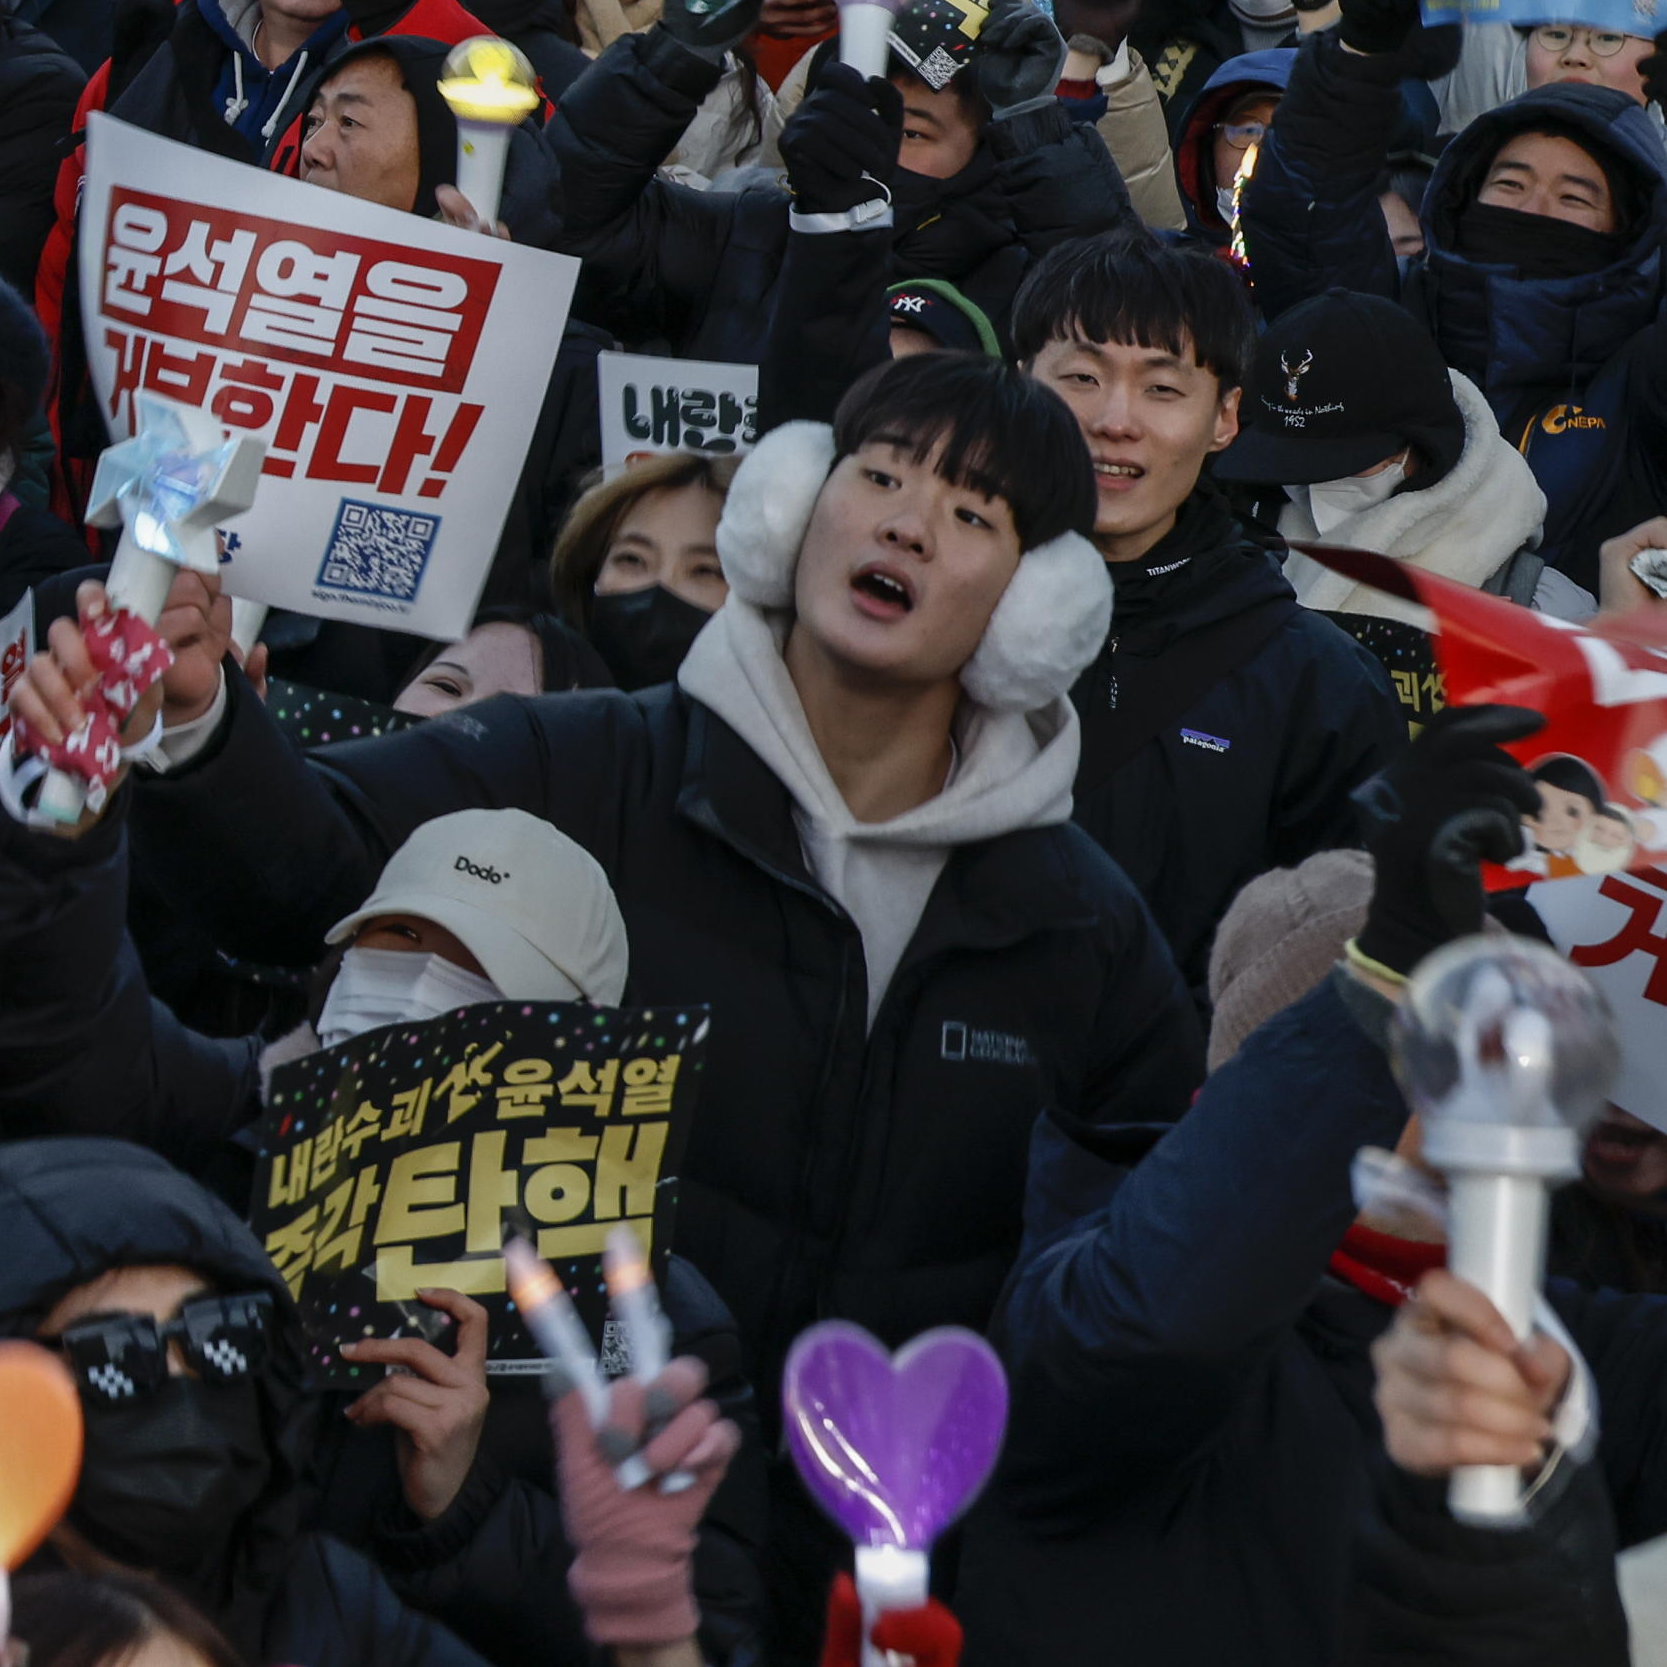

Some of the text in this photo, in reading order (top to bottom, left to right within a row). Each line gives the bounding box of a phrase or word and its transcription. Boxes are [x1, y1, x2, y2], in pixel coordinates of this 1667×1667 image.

[105, 202, 469, 377] 윤석열을
[894, 296, 926, 313] NY
[1567, 415, 1606, 429] NEPA
[1182, 735, 1225, 753] patagonia
[269, 1053, 680, 1209] 내란수괴 윤석열
[264, 1122, 667, 1305] 즉각 탄핵
